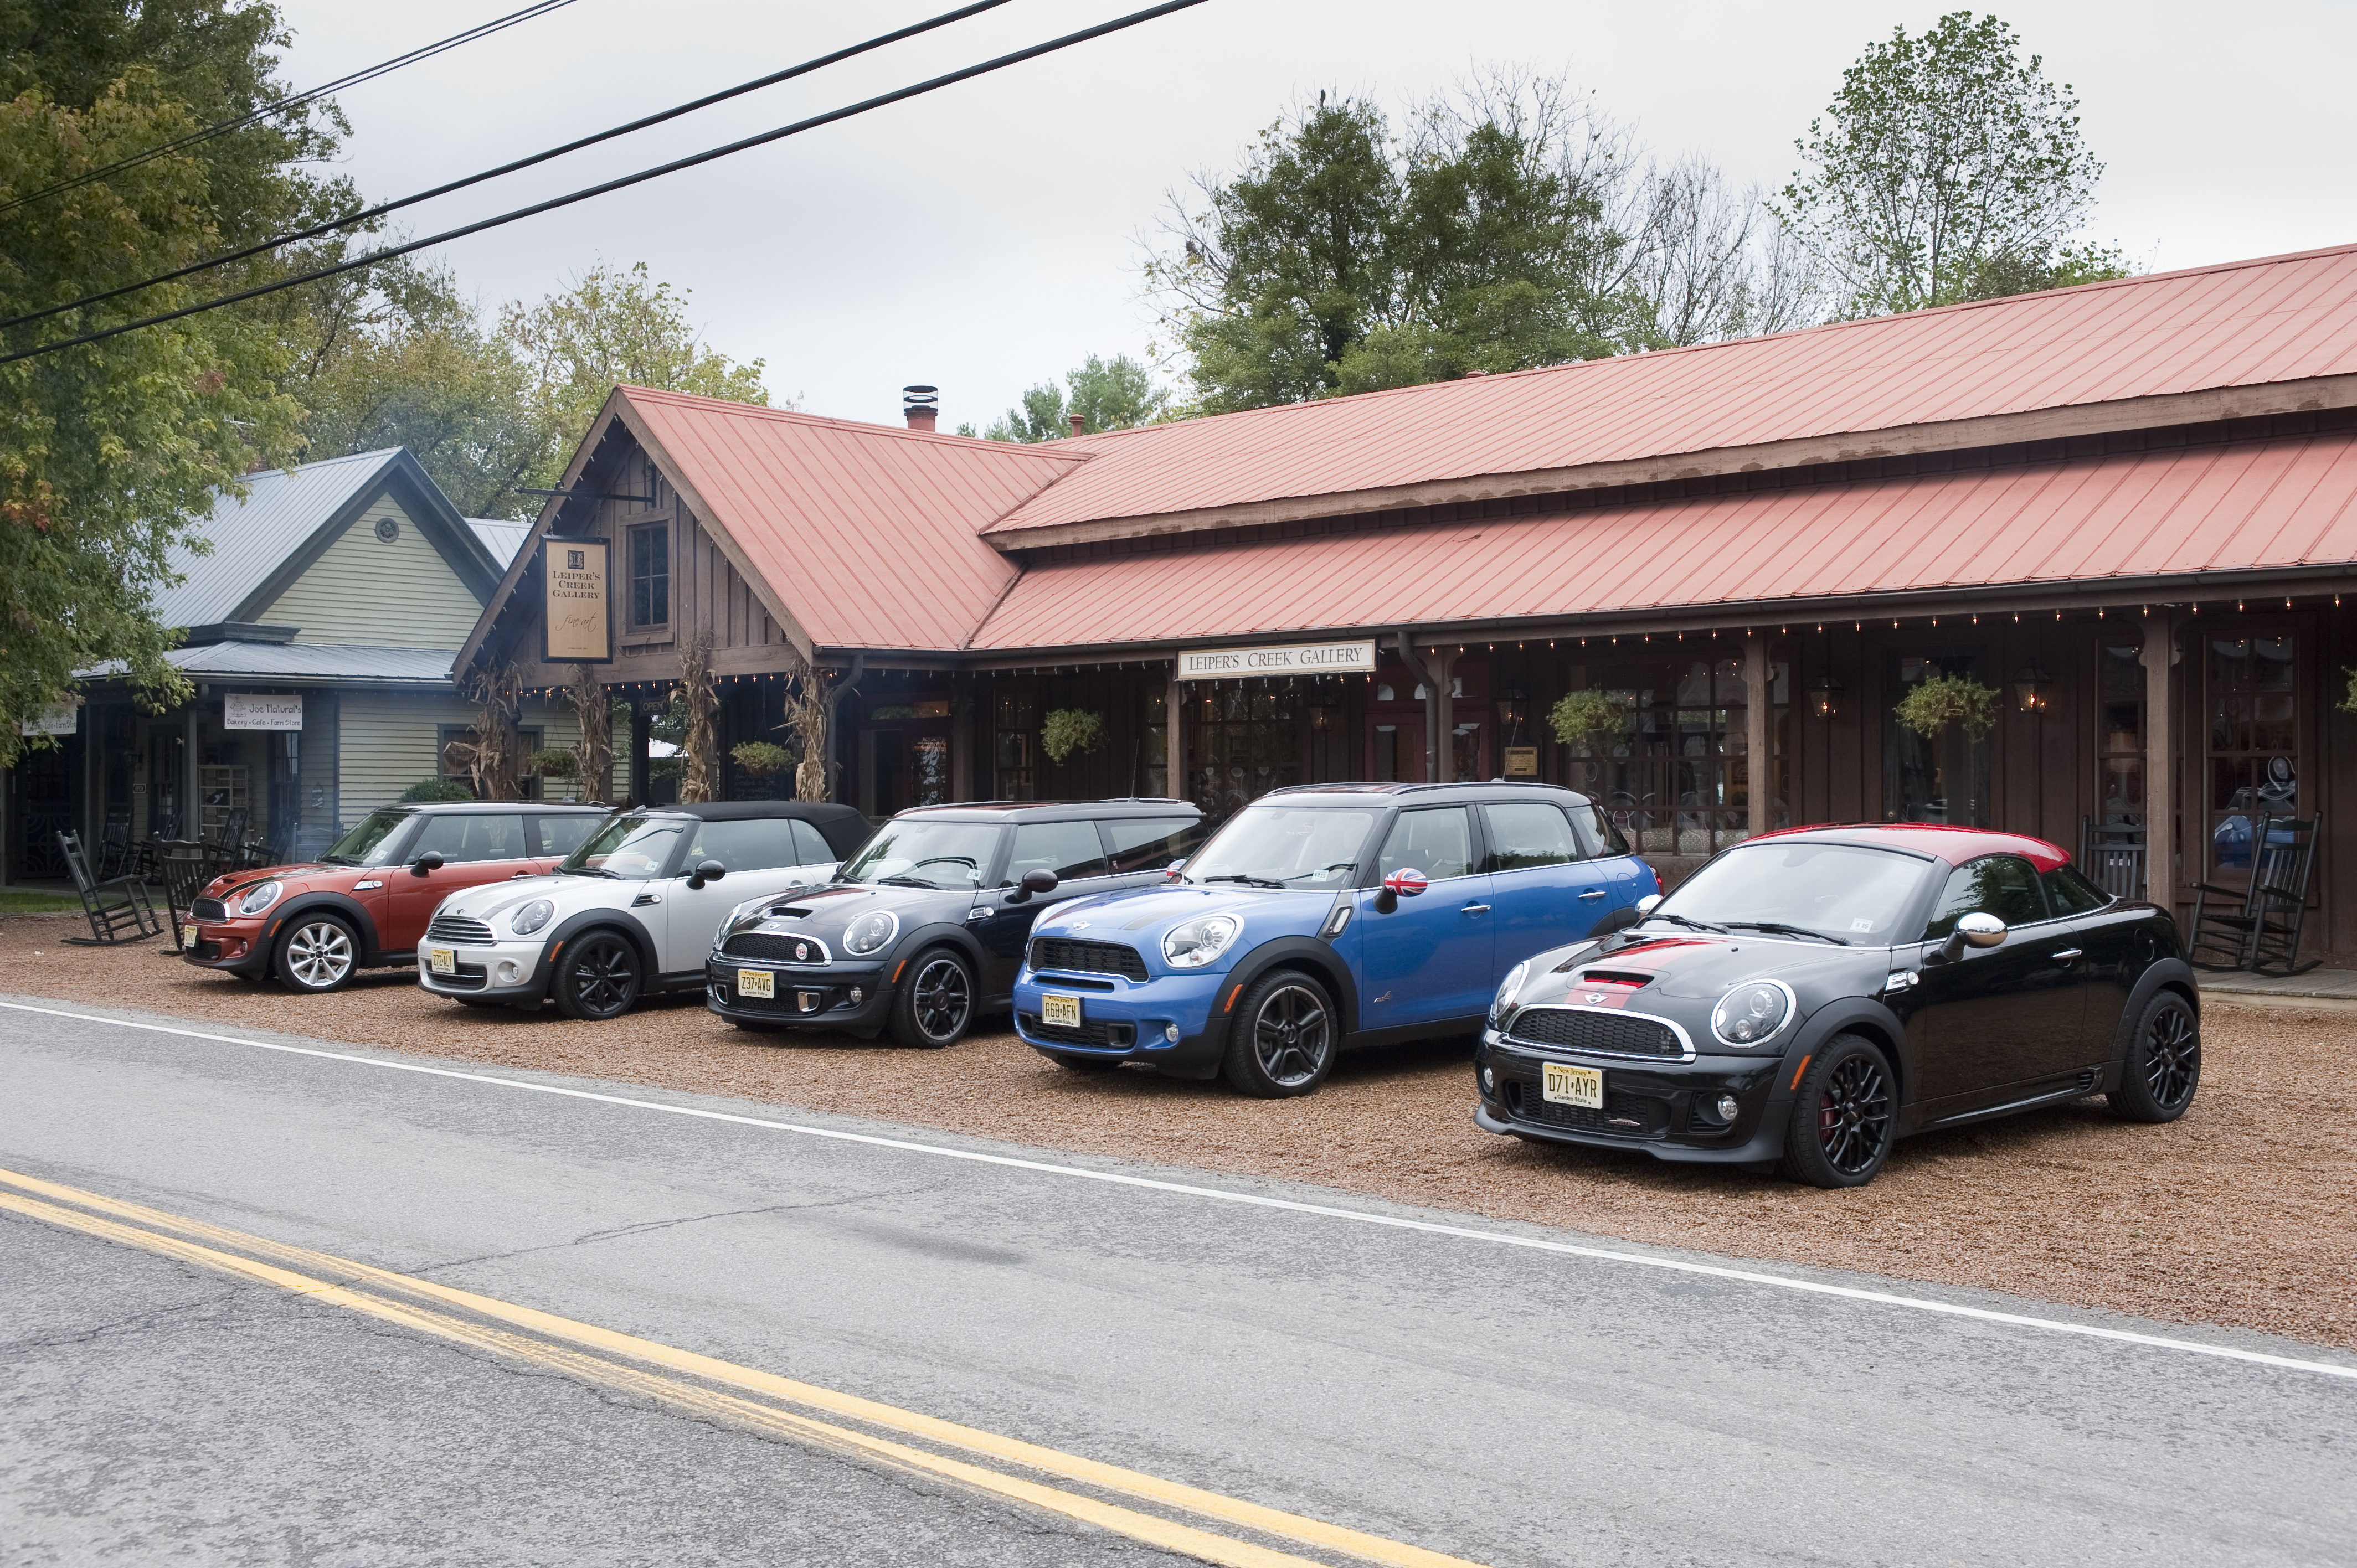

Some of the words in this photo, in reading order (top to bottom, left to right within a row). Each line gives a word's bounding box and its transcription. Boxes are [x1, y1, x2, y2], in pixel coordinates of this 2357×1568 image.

[553, 571, 600, 581] LEIPER'S
[558, 580, 595, 590] CREEK
[552, 590, 600, 599] GALLERY
[555, 614, 581, 631] fine
[580, 612, 596, 632] art
[1189, 655, 1239, 671] LEIPER'S
[1248, 652, 1293, 667] CREEK
[1300, 647, 1363, 664] GALLERY
[249, 704, 264, 713] Joe
[266, 704, 302, 714] Natural's
[227, 718, 248, 727] Bakery
[1570, 1068, 1587, 1077] Jersey
